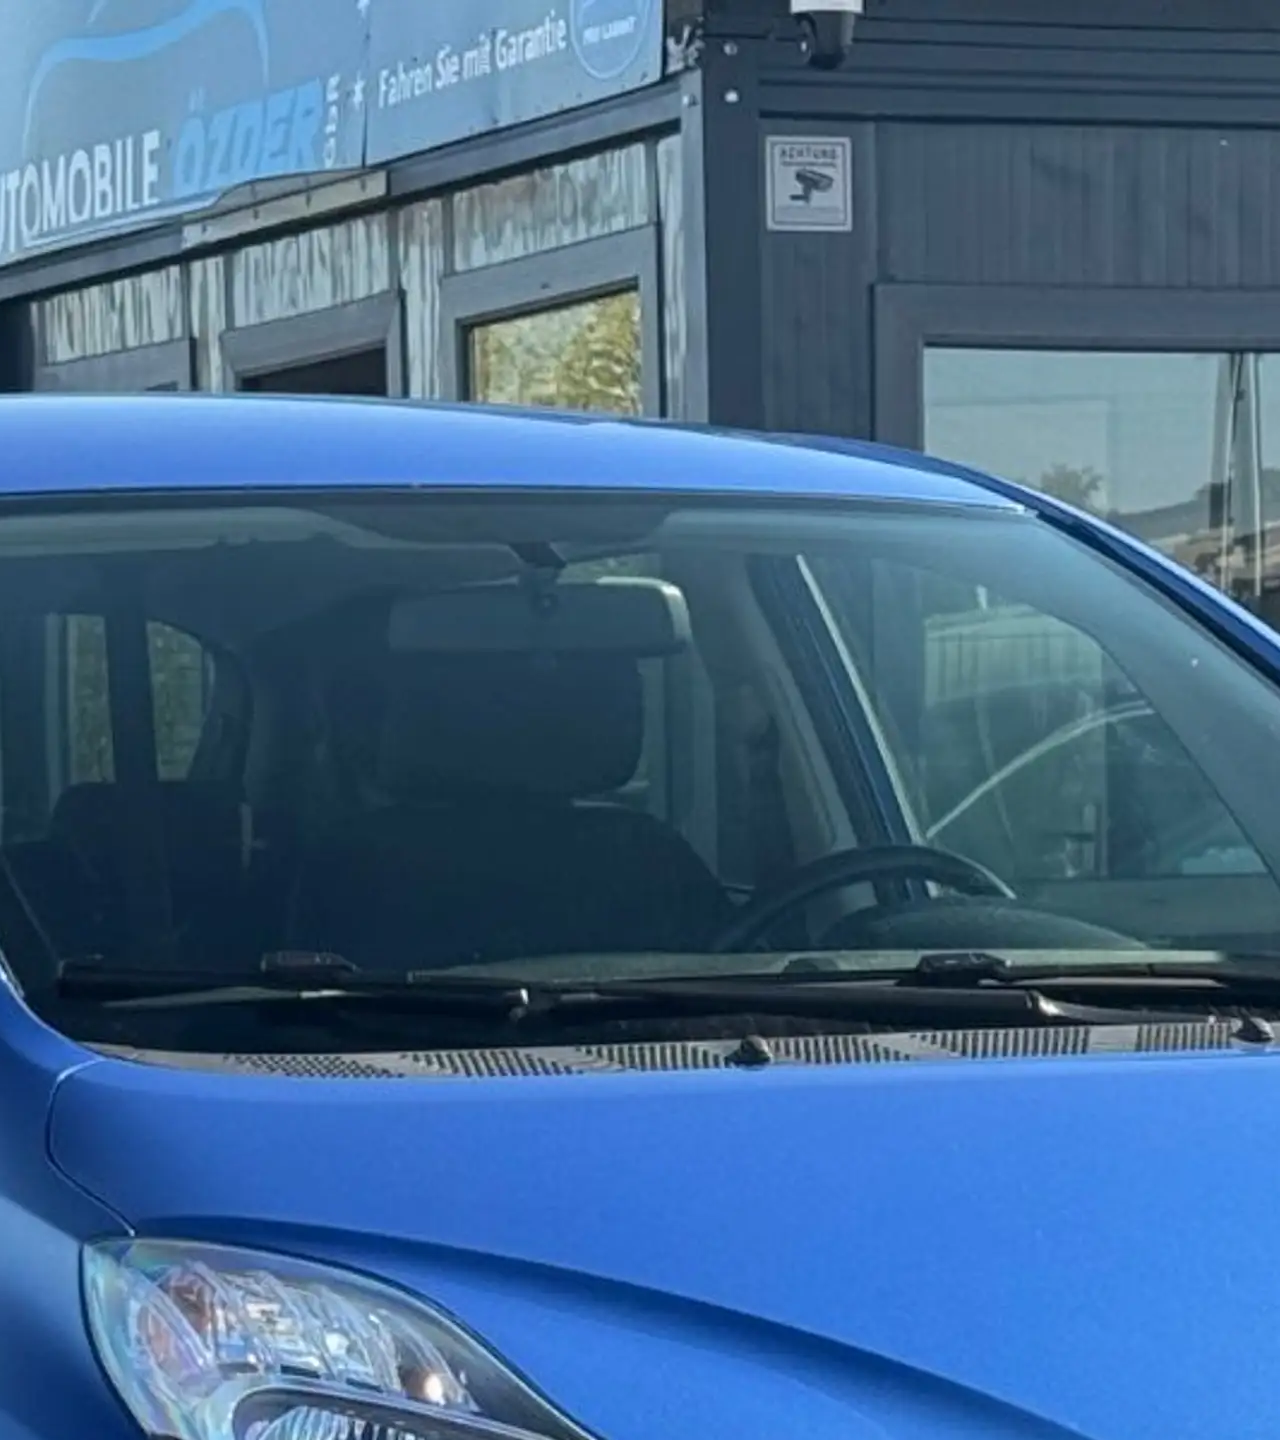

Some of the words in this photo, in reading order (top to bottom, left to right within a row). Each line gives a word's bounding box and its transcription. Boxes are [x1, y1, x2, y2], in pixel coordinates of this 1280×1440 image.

[378, 61, 432, 109] Fahren
[434, 43, 460, 89] Sie
[463, 33, 491, 81] mit
[495, 8, 567, 70] Garantie
[173, 75, 323, 197] ÖZDER
